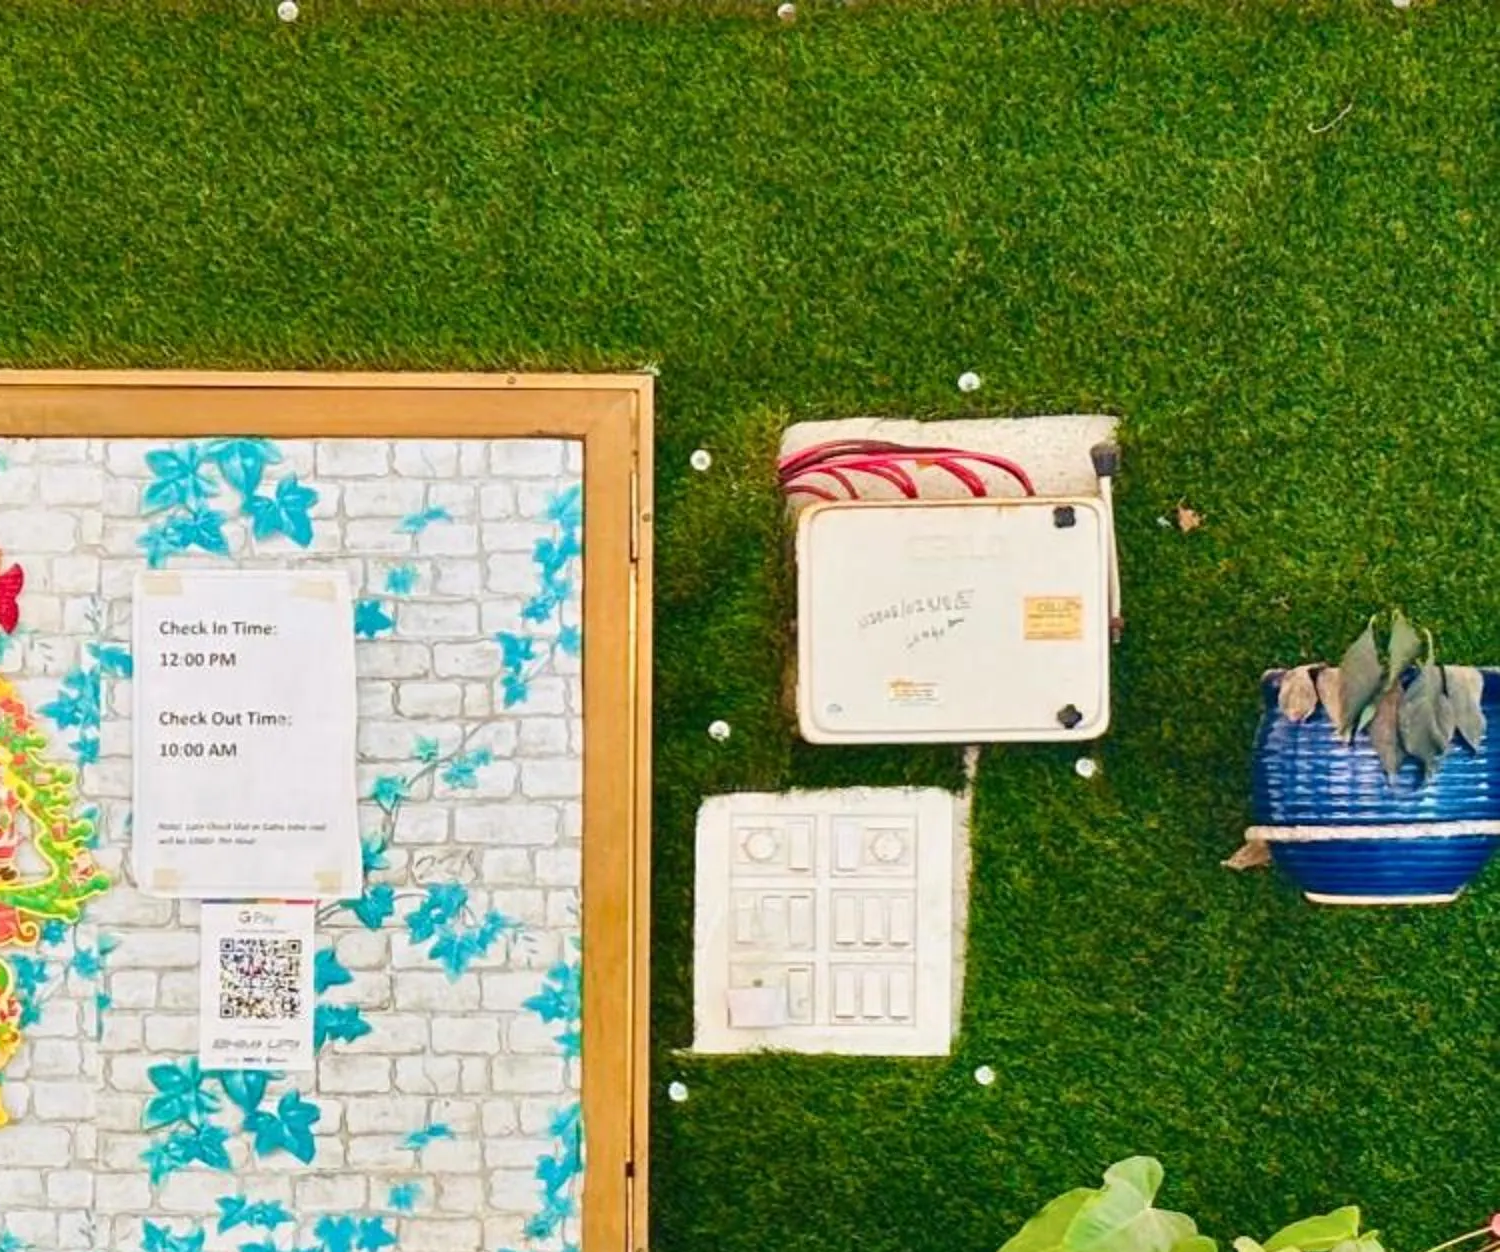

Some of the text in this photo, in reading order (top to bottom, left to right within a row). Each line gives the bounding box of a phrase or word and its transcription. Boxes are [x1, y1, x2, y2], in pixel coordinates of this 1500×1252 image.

[159, 621, 278, 636] Check In Time:
[160, 653, 237, 667] 12:00 PM
[159, 711, 293, 726] Check Out Time:
[159, 743, 237, 757] 10:00 AM
